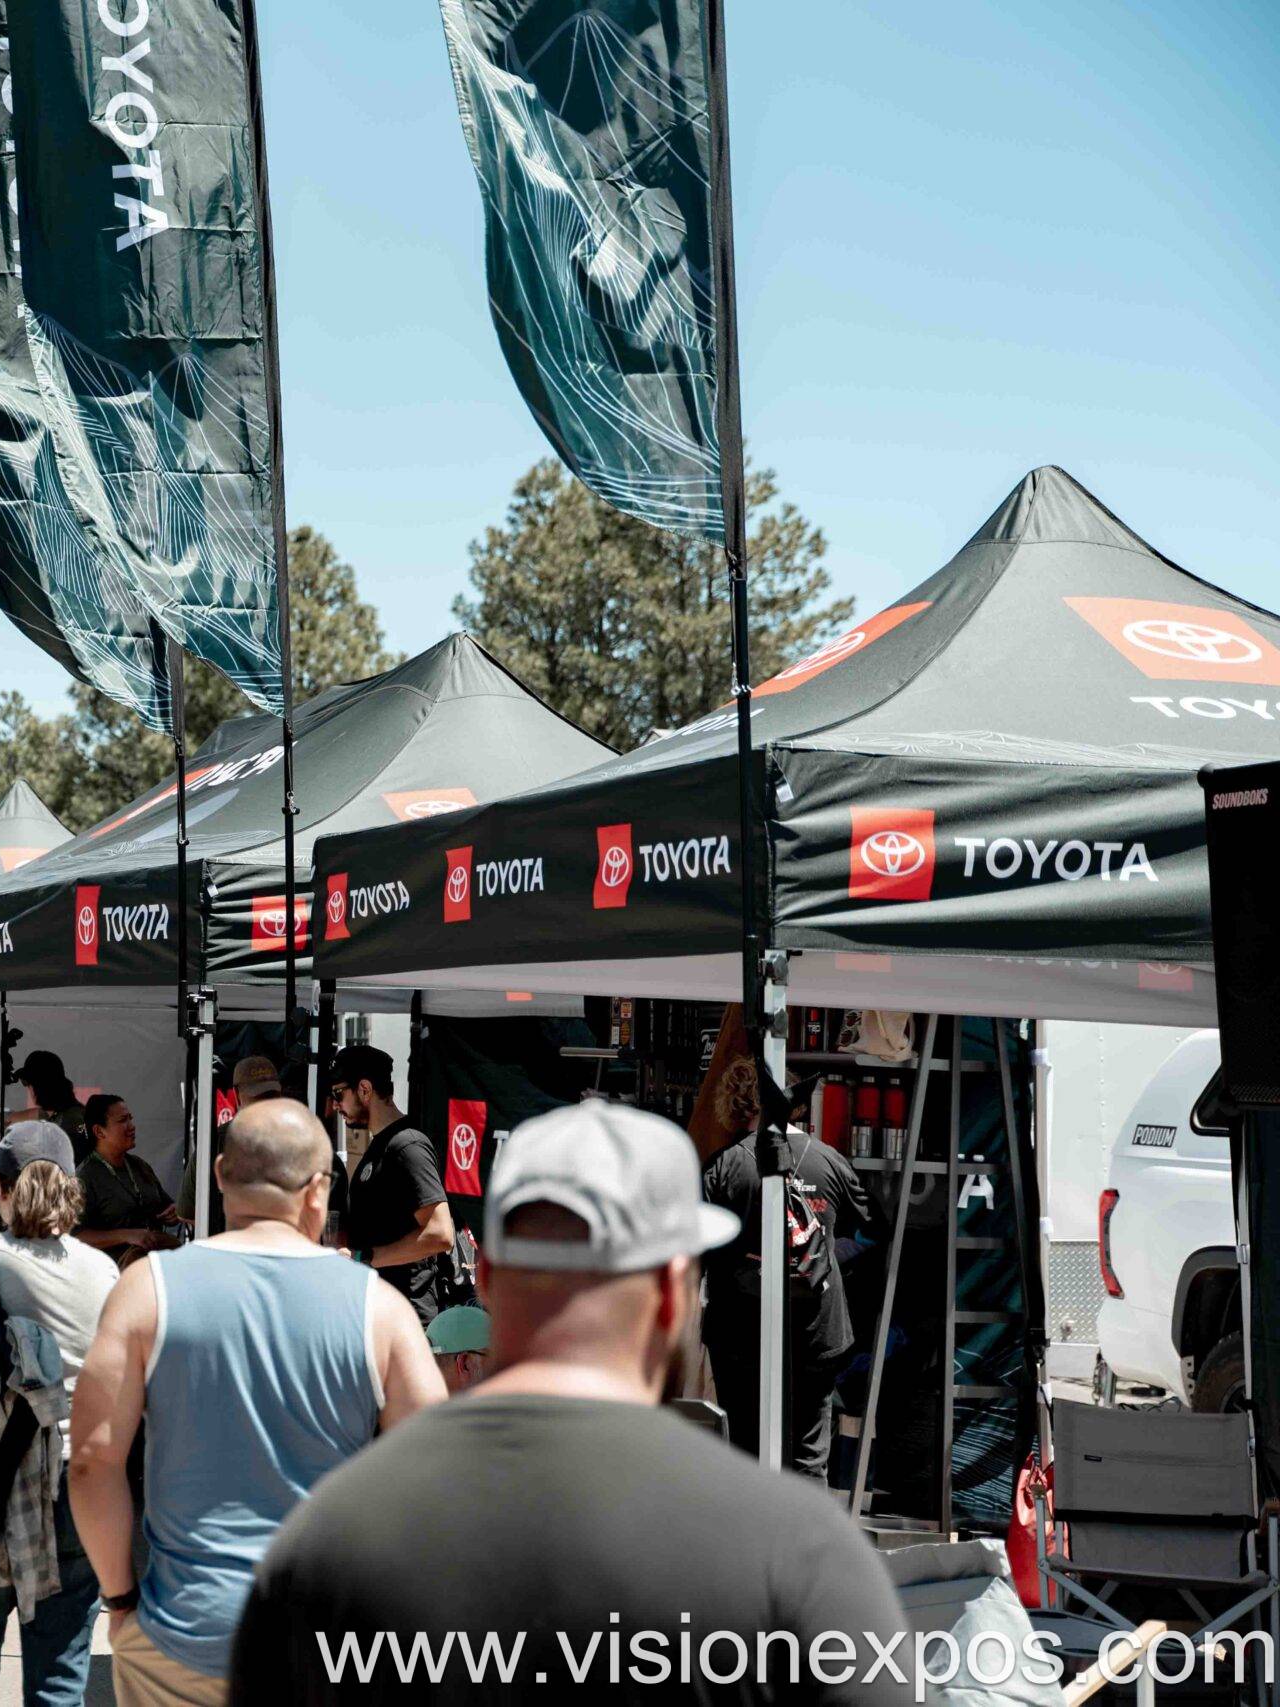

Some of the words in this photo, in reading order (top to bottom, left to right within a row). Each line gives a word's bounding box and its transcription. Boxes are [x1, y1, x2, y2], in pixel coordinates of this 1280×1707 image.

[1128, 695, 1280, 721] TOY
[476, 856, 545, 897] TOYOTA
[638, 834, 732, 883] TOYOTA
[954, 836, 1160, 883] TOYOTA
[349, 879, 410, 919] TOYOTA
[102, 903, 170, 942] TOYOTA
[1132, 1126, 1176, 1147] PODIUM
